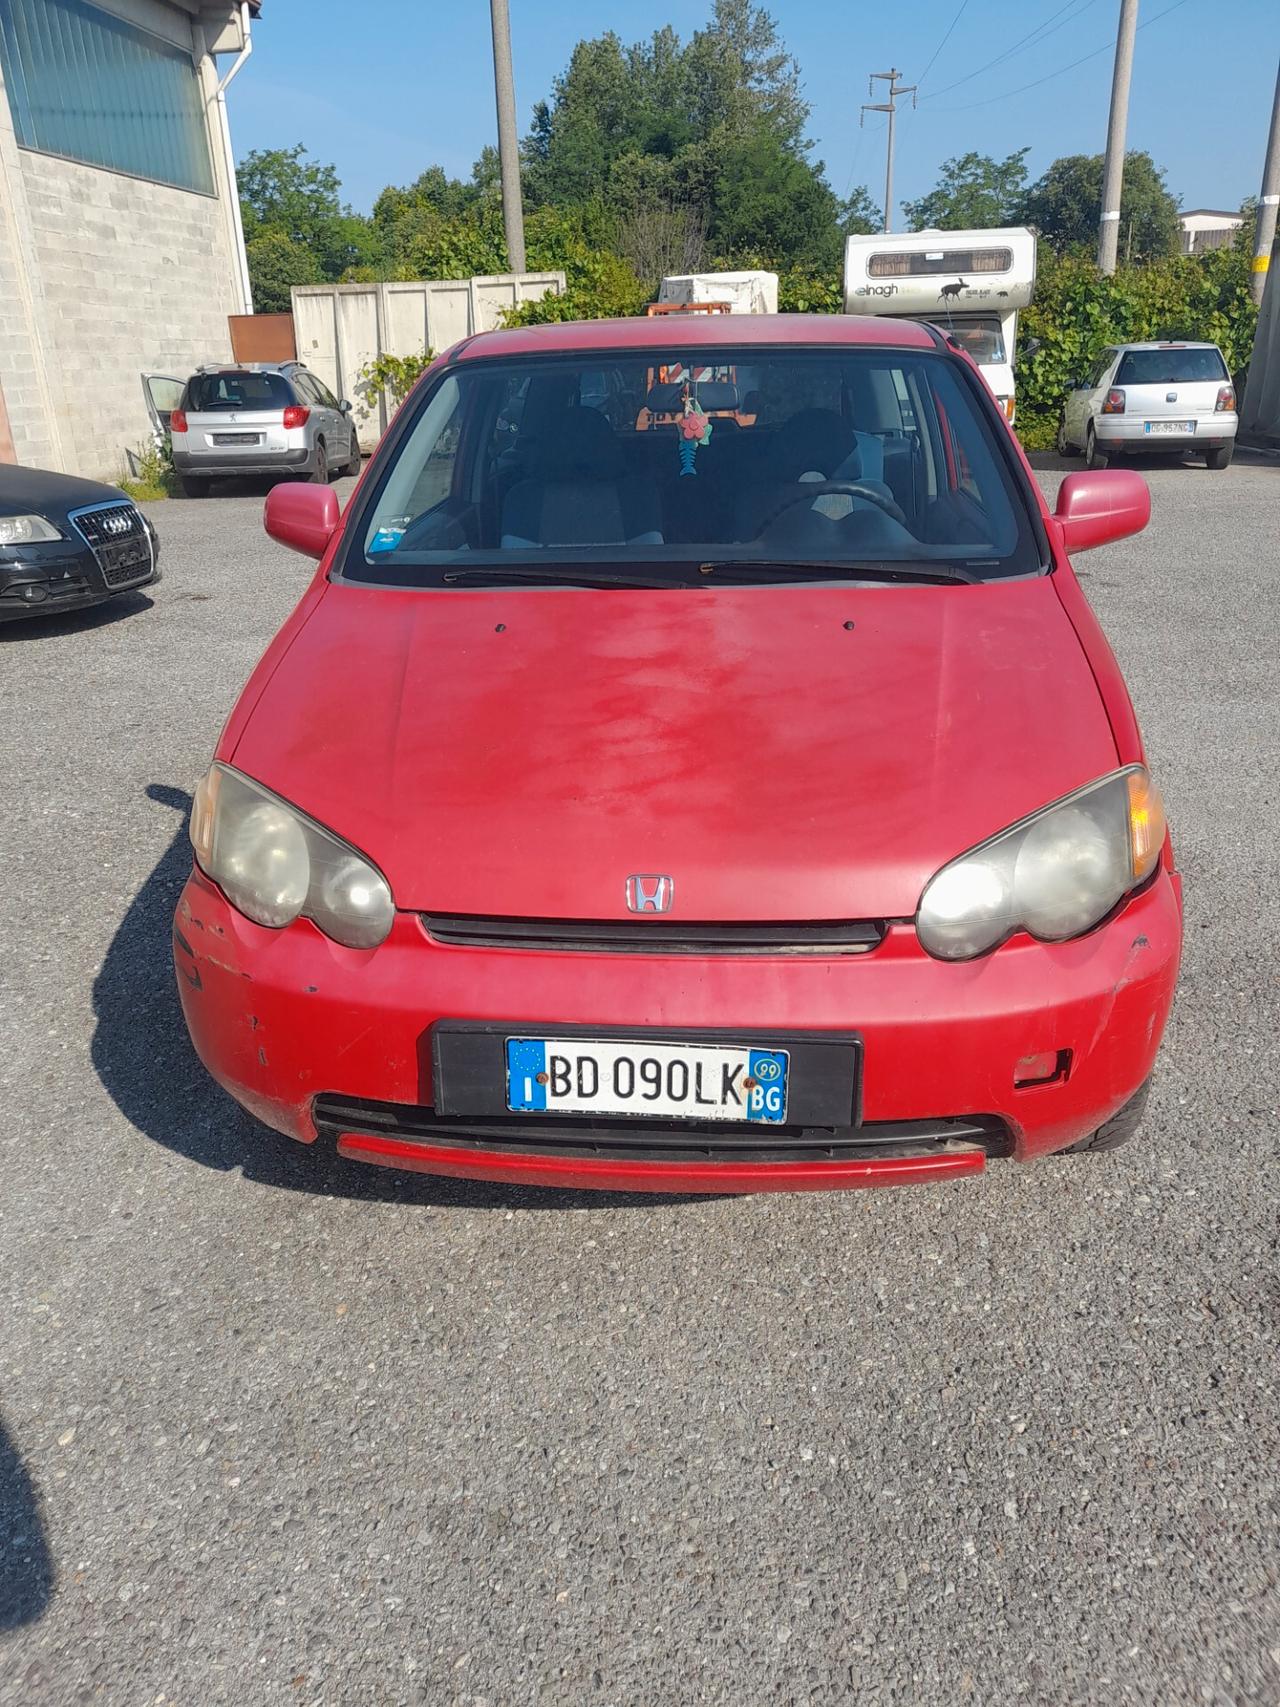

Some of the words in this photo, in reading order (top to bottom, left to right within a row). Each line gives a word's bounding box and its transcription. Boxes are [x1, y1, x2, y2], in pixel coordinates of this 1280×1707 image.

[855, 283, 898, 298] elnagh
[550, 1055, 599, 1098] BD
[613, 1056, 744, 1106] 090LK
[760, 1063, 777, 1078] 99
[751, 1084, 780, 1111] BG
